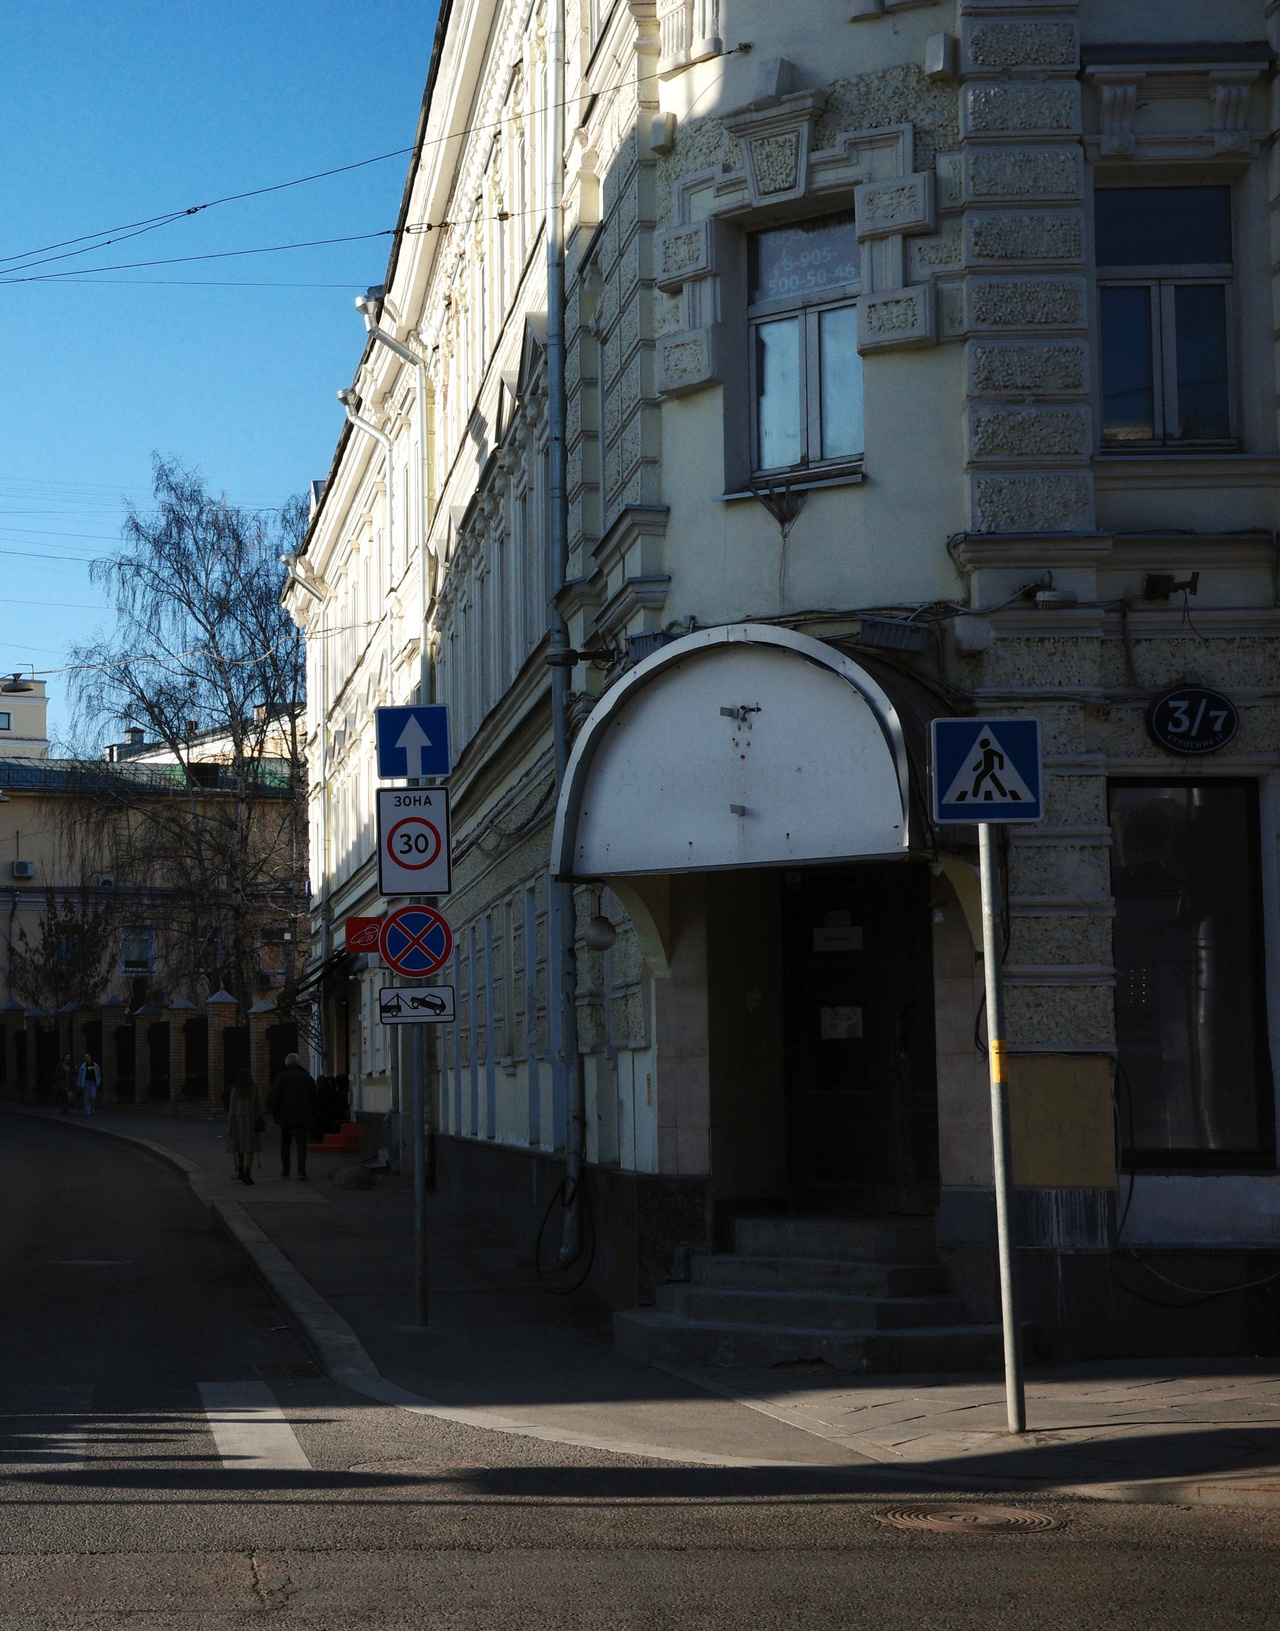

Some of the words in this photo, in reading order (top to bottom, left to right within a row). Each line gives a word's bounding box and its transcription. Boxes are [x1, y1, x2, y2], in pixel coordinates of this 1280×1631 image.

[1167, 698, 1228, 737] 3/7
[394, 796, 433, 807] ЗОНА
[399, 833, 429, 855] 30
